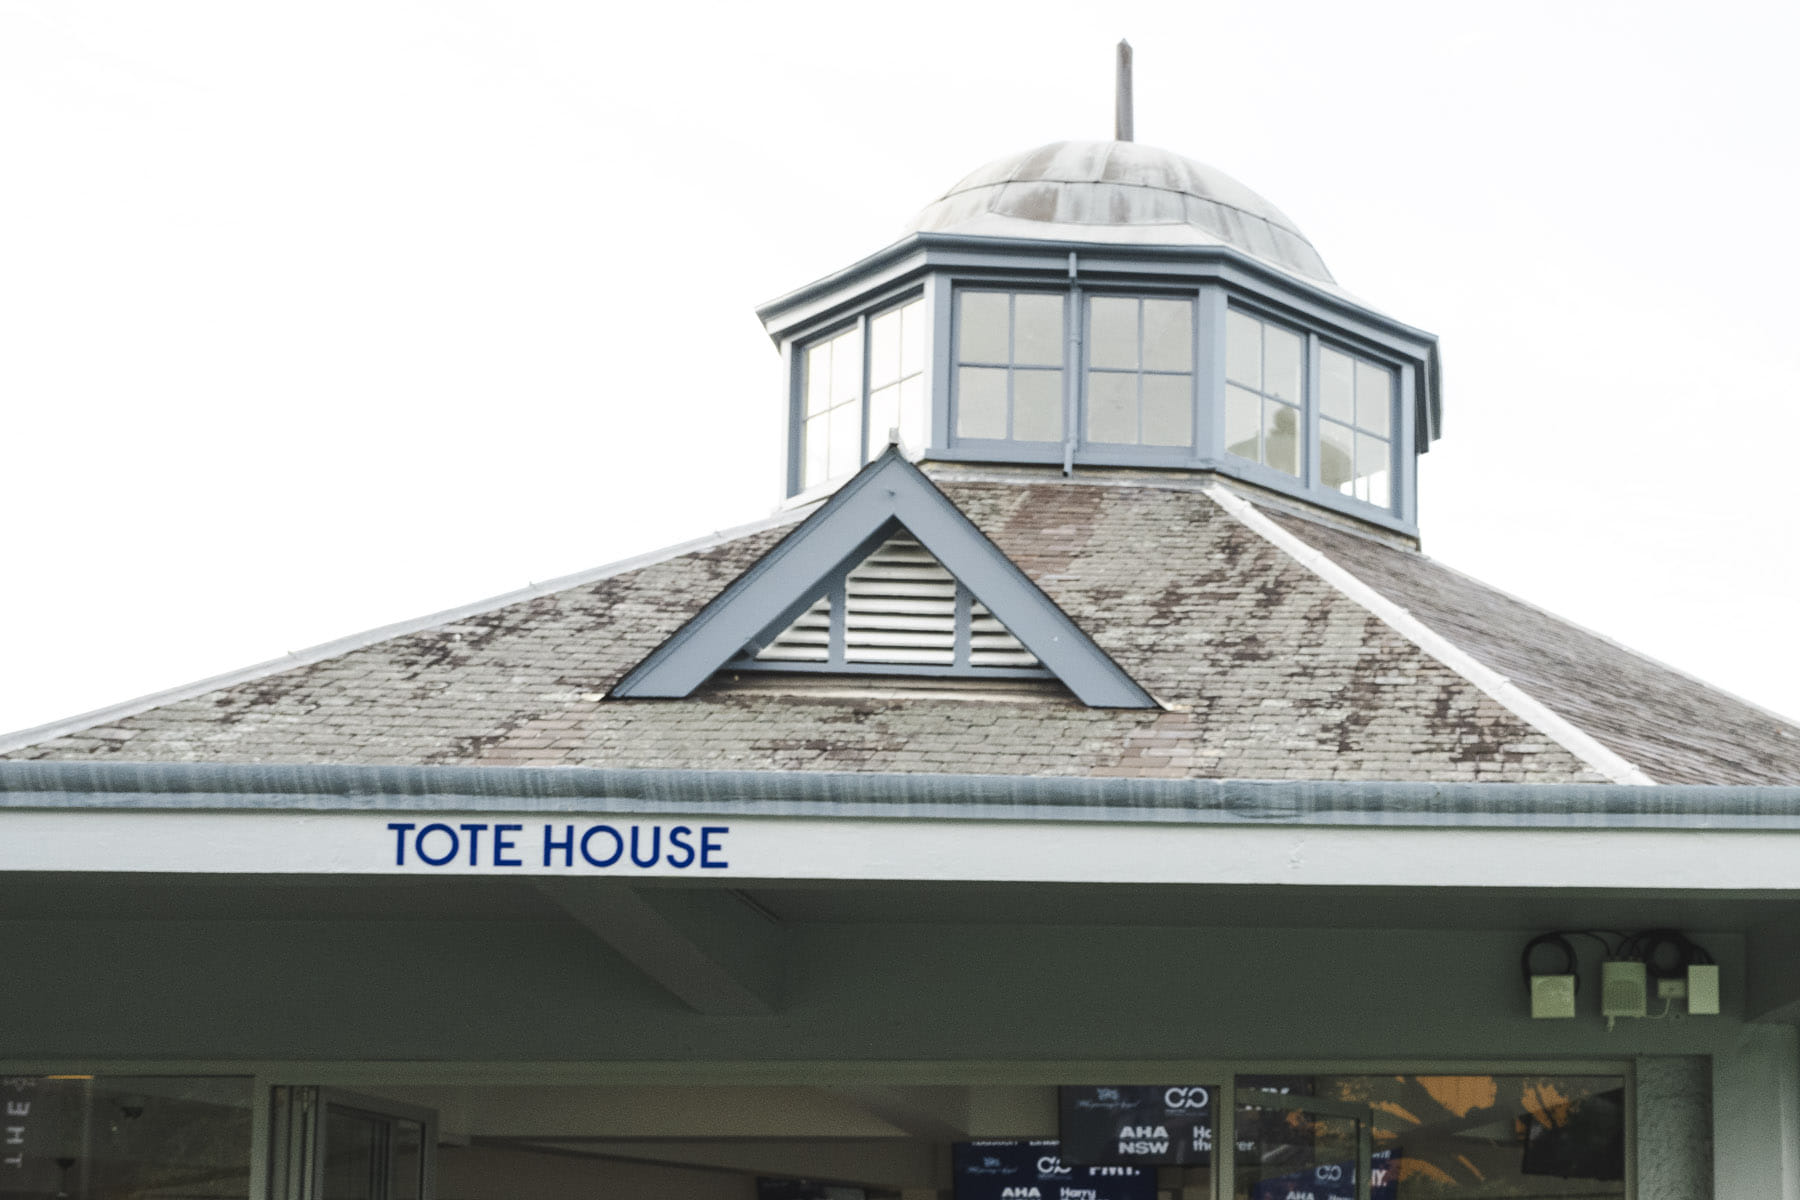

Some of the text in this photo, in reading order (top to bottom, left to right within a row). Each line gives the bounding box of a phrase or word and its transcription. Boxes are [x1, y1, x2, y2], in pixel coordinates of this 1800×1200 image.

[387, 823, 730, 868] TOTE HOUSE
[1119, 1126, 1169, 1139] AHA
[1118, 1141, 1169, 1155] NSW
[1001, 1187, 1042, 1198] AHA
[1060, 1187, 1096, 1200] Harry
